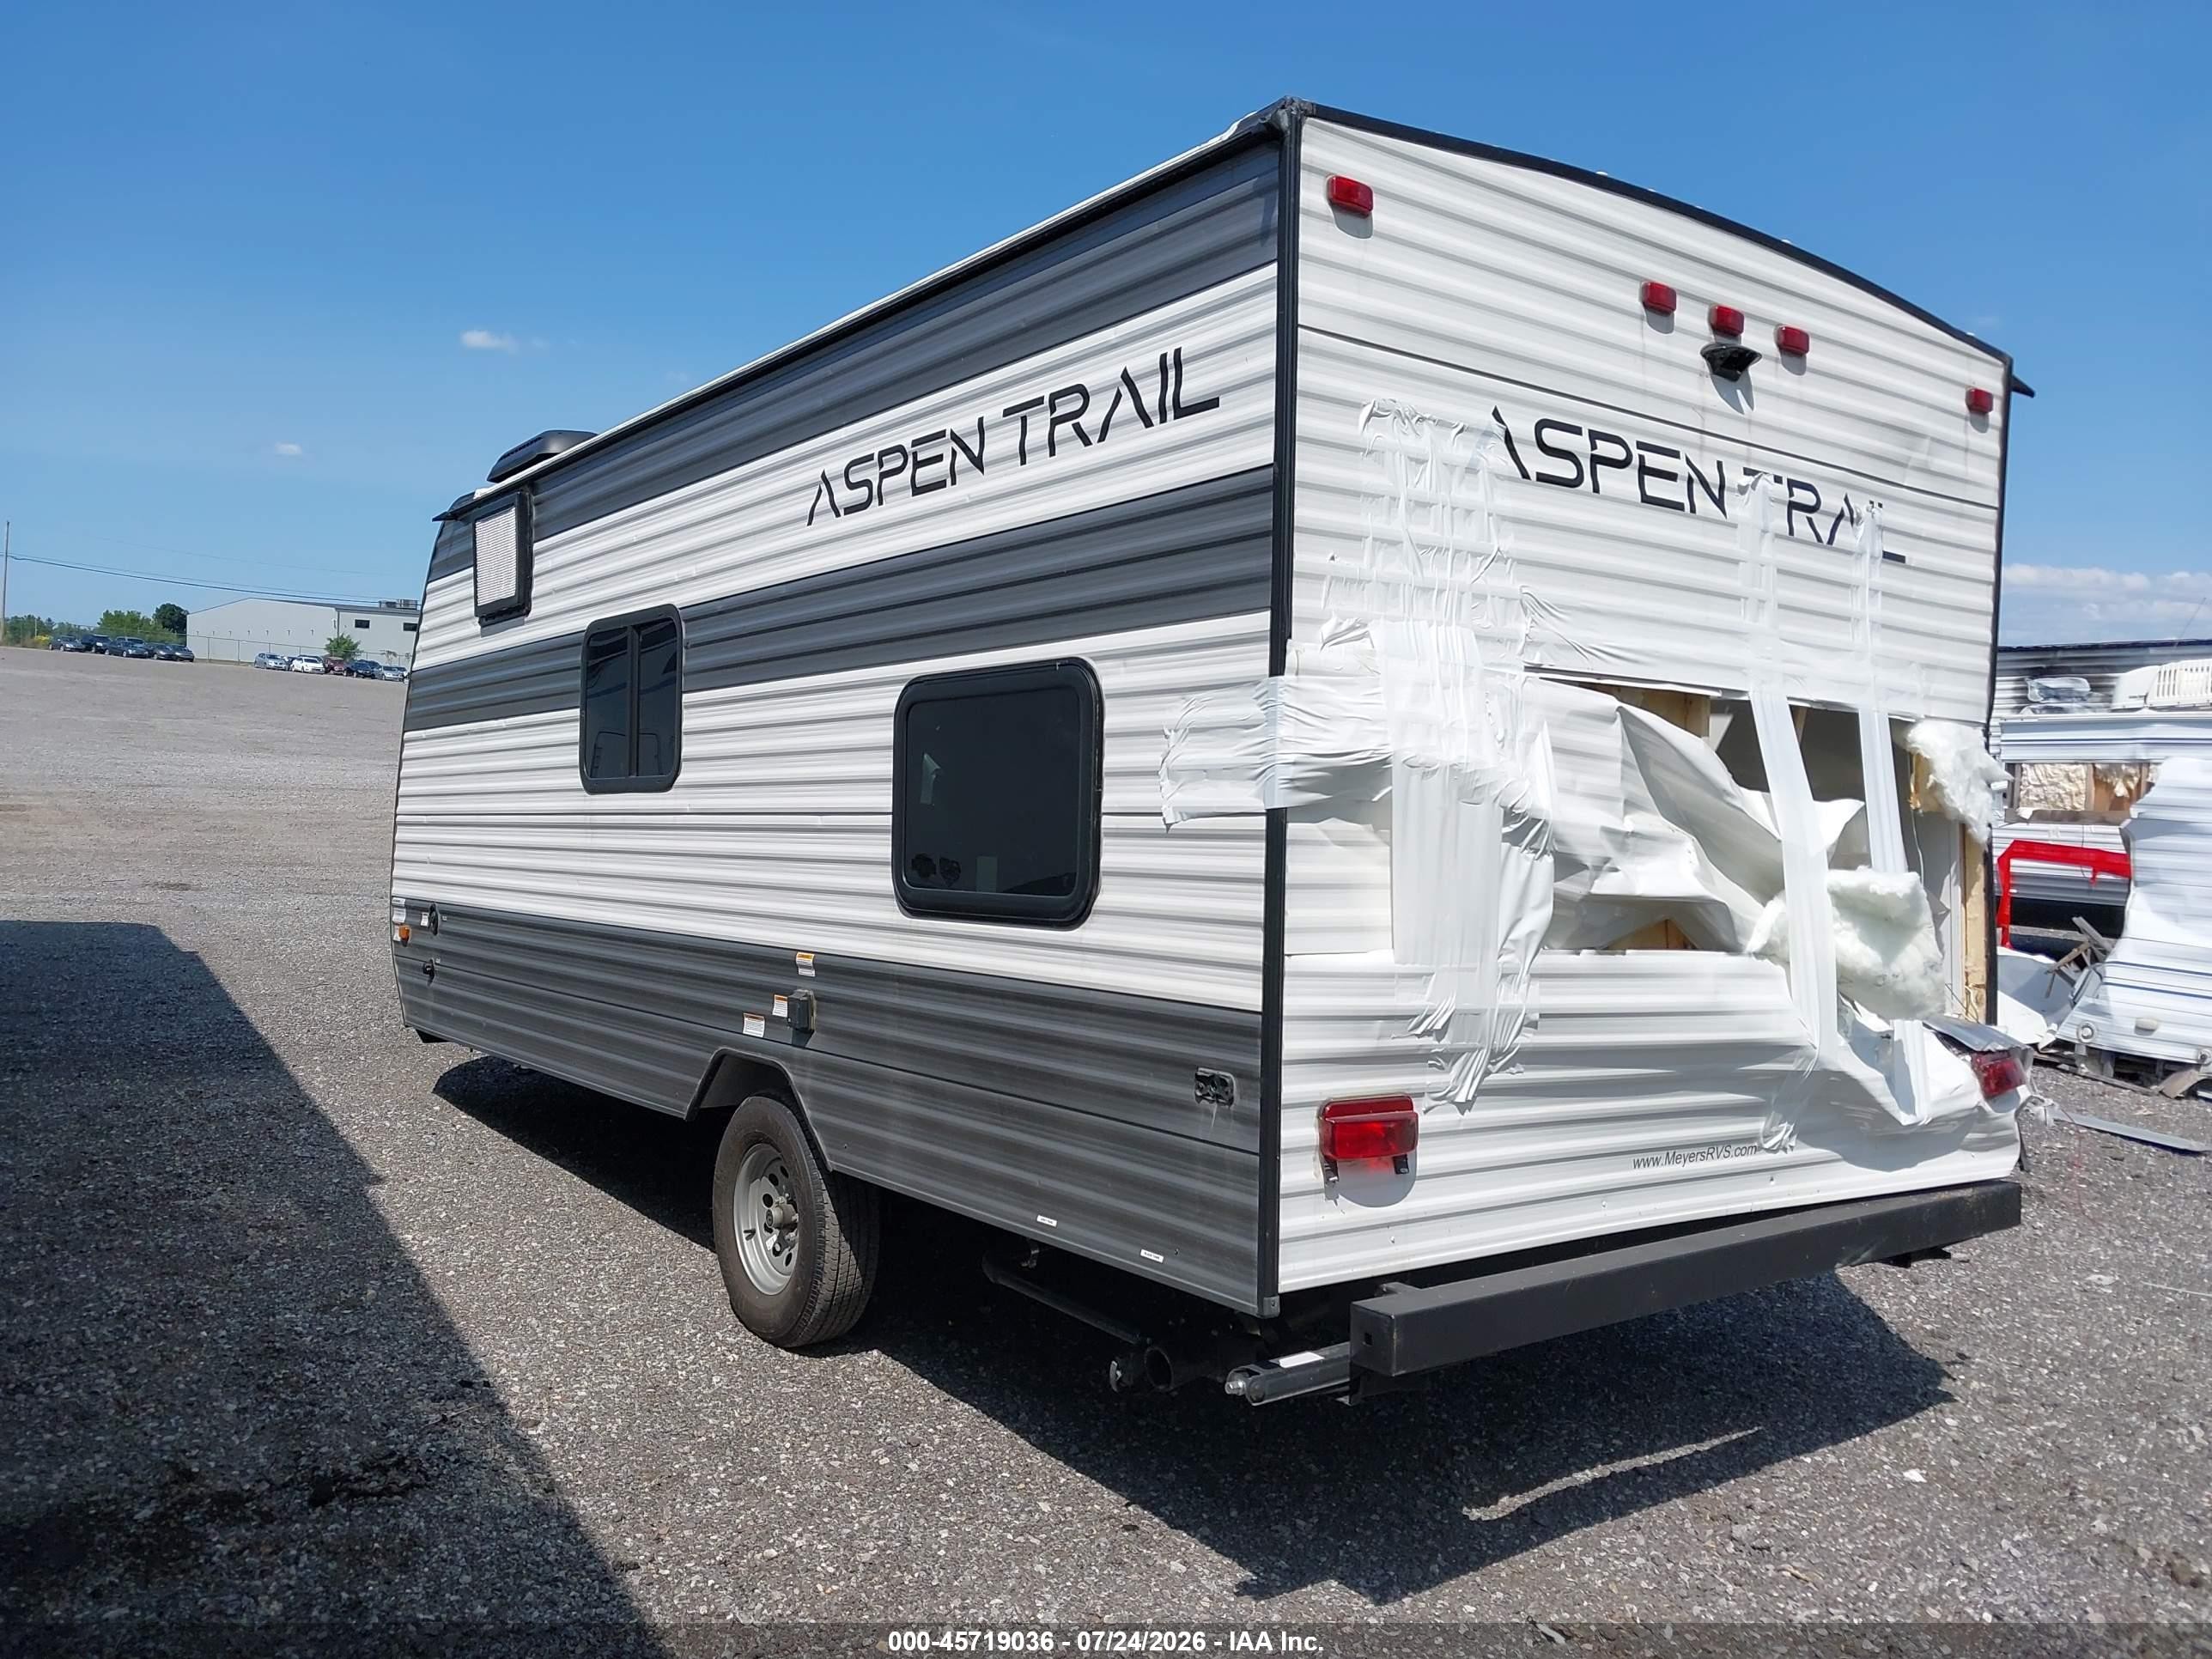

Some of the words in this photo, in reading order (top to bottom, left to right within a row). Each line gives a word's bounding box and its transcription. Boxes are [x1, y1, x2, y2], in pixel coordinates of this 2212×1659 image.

[805, 416, 986, 526] ASPEN
[1002, 346, 1221, 467] TRAIL
[1632, 1144, 1758, 1170] www.MeyersRVS.com
